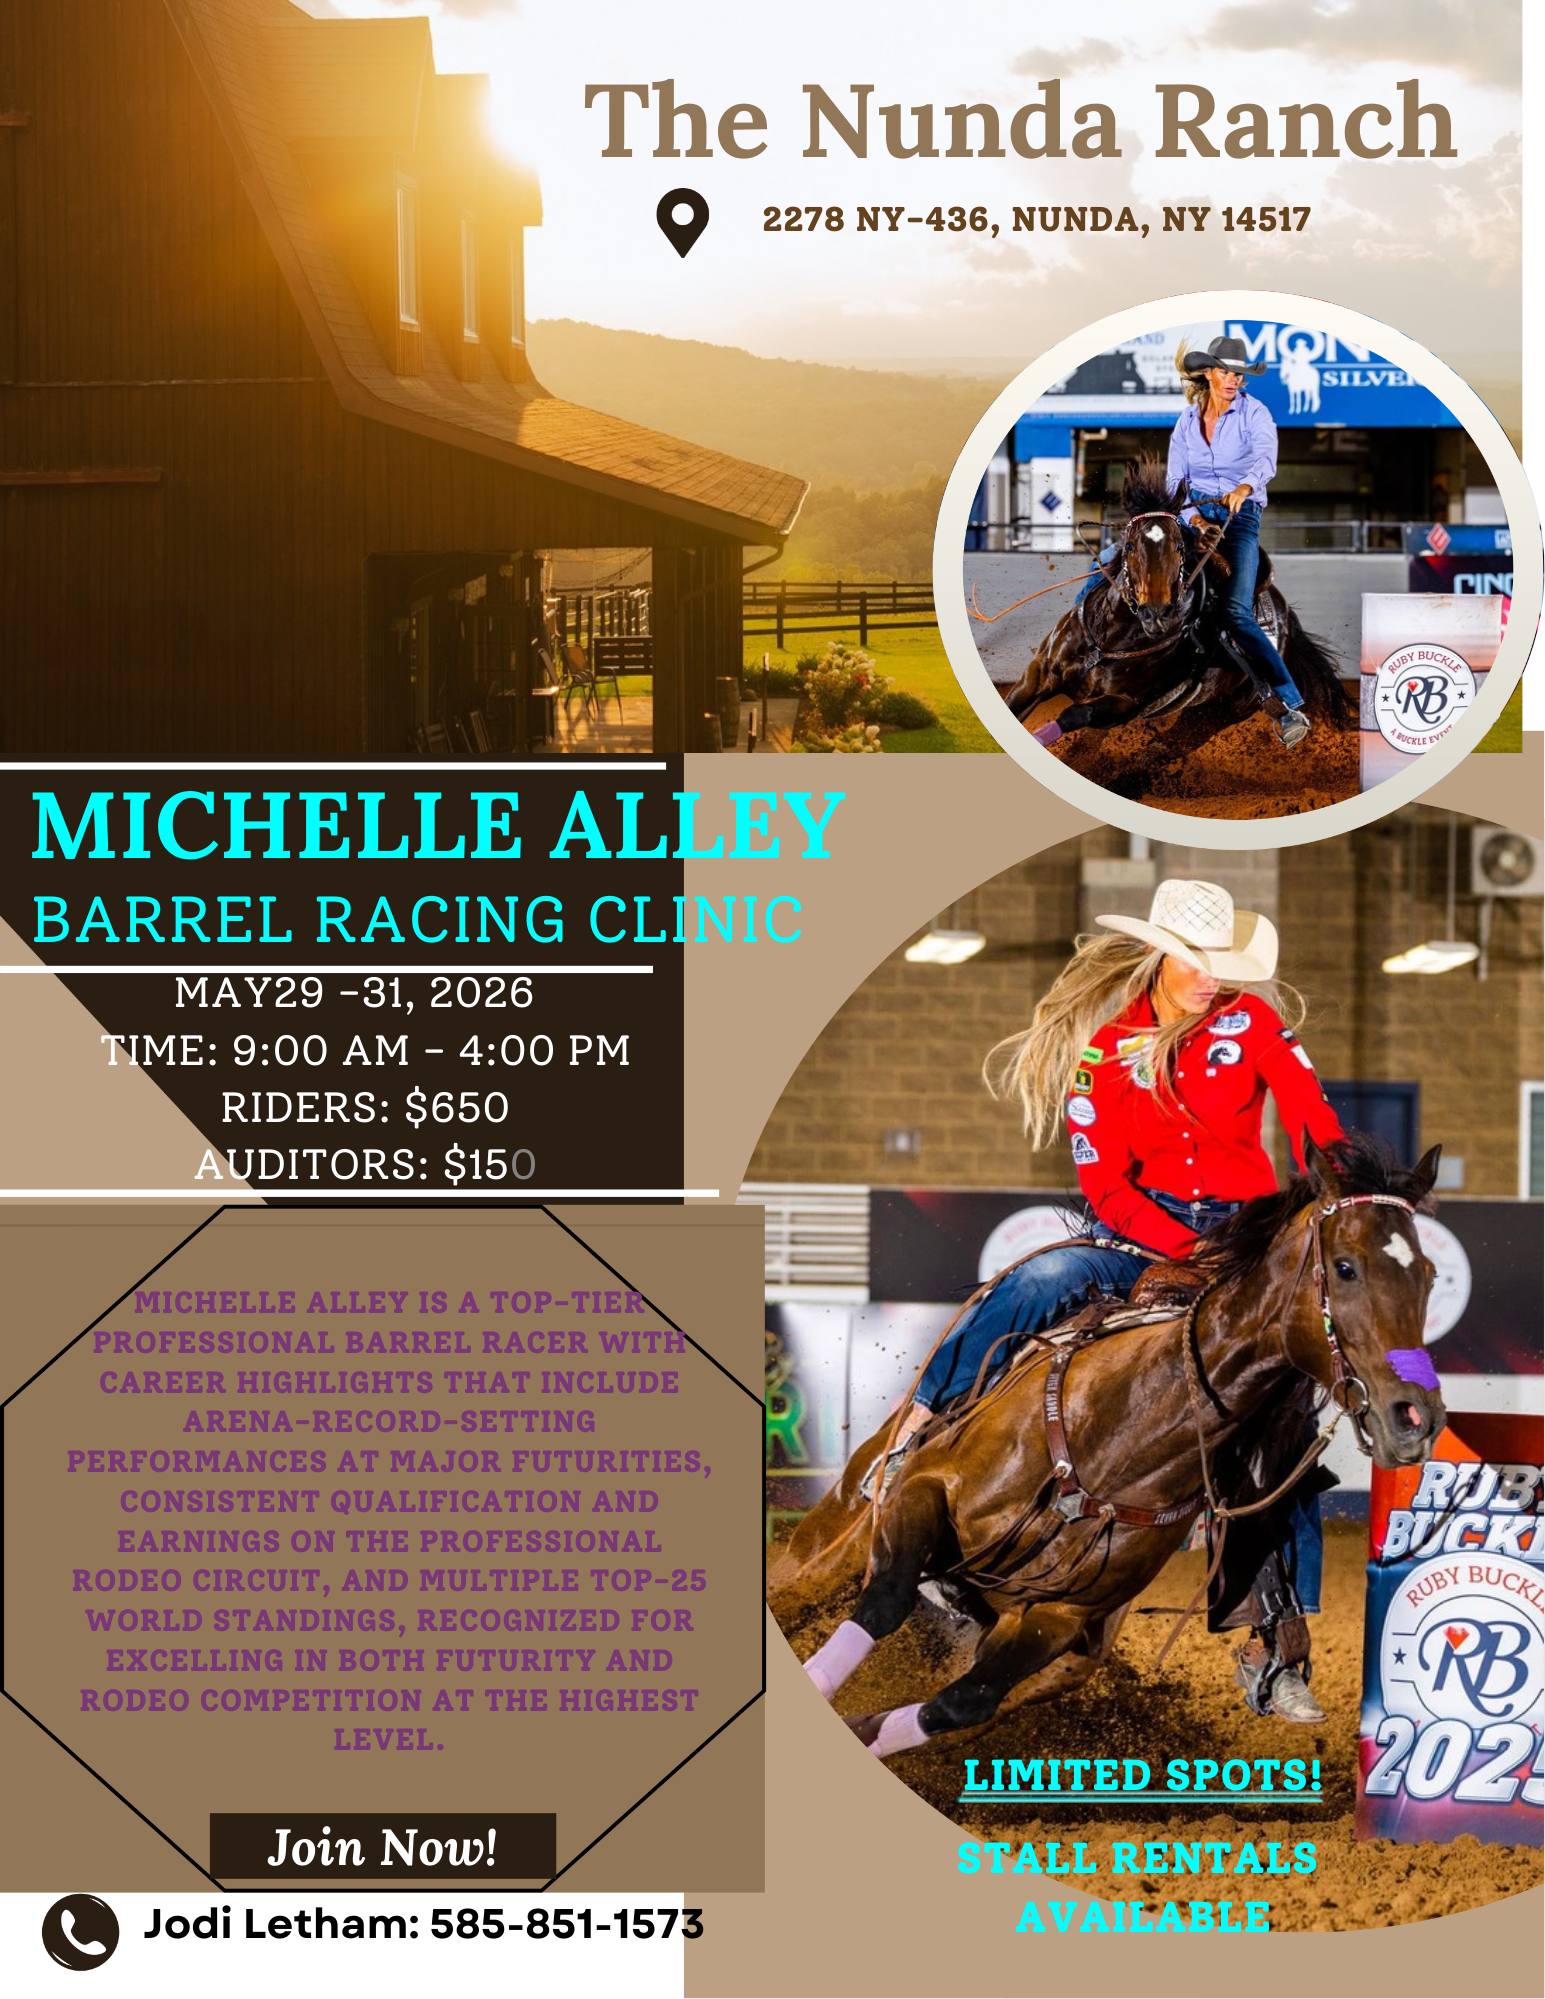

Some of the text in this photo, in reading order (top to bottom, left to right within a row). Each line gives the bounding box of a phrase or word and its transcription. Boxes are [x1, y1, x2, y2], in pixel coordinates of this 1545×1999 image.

[1387, 650, 1462, 674] RUBY BUCKLE
[1406, 1565, 1545, 1615] RUBY BUCKL
